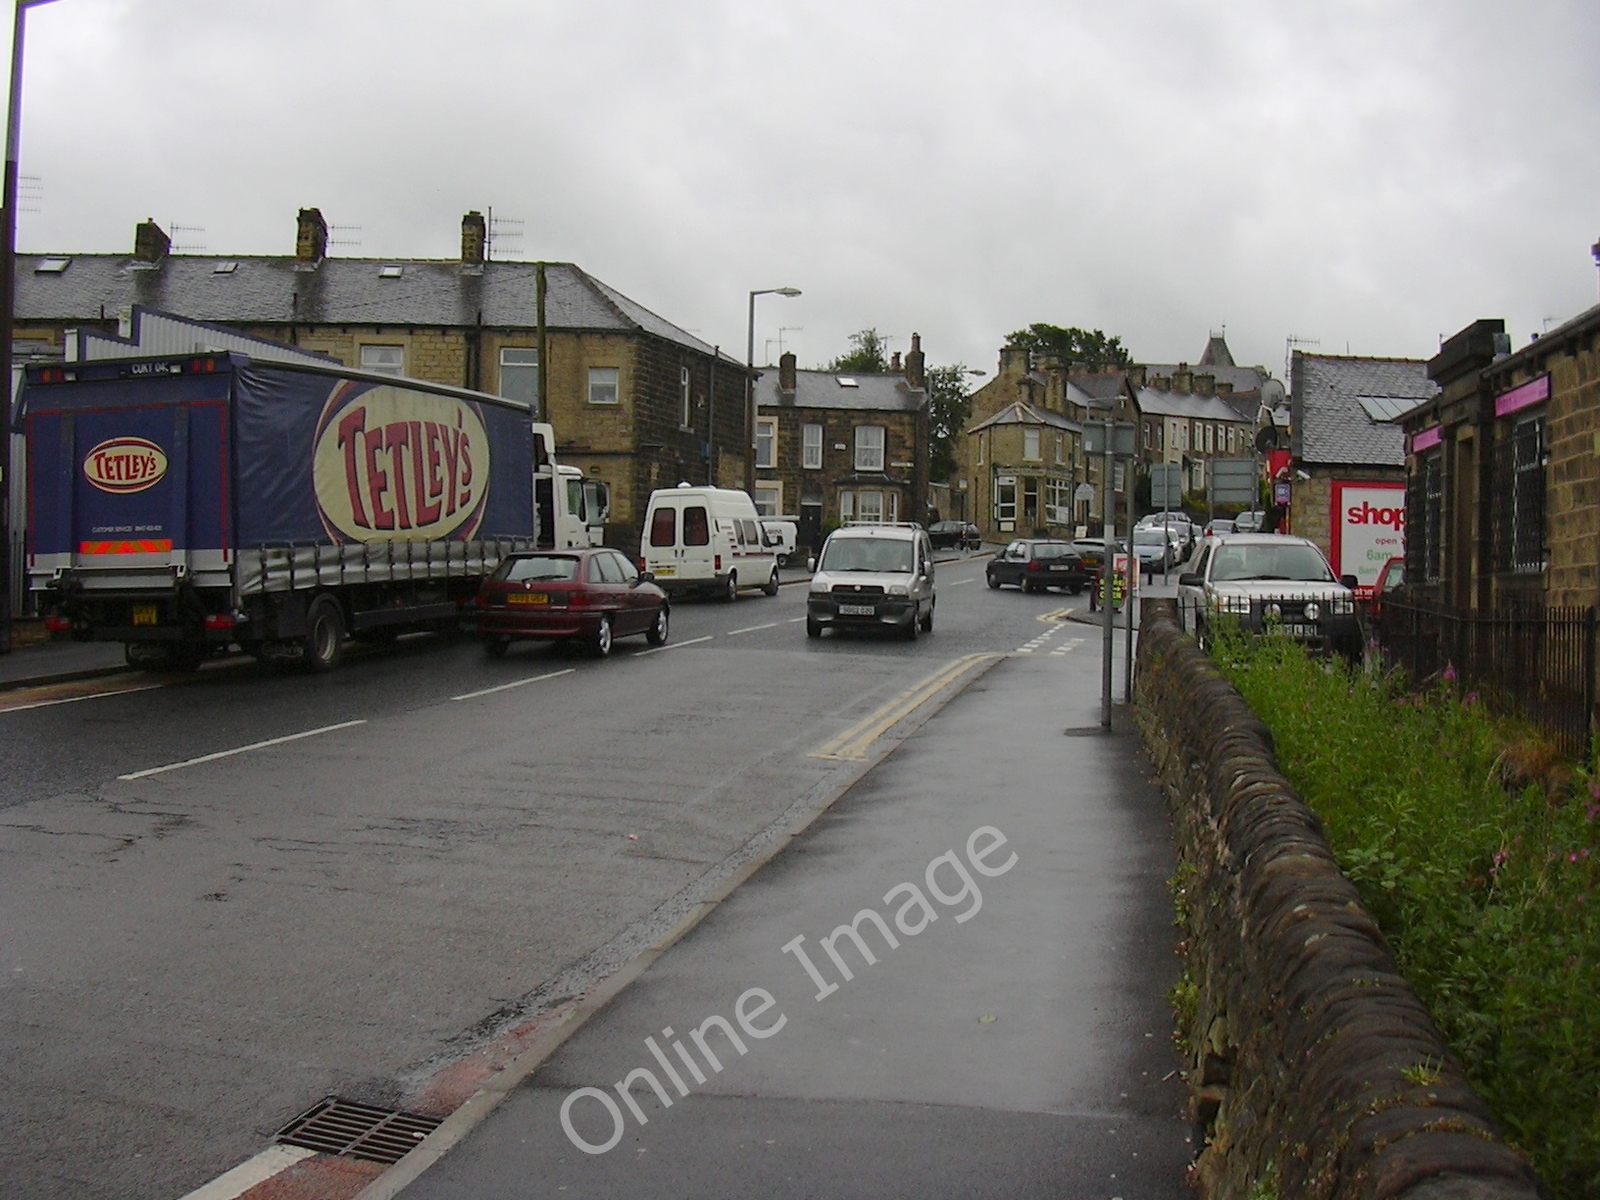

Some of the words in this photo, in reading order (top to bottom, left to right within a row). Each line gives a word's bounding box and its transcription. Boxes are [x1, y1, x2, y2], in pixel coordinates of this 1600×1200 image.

[94, 451, 157, 480] TETLEY'S
[338, 406, 473, 530] TETLEY'S
[1347, 501, 1406, 531] shop
[1366, 549, 1393, 561] 6am
[1375, 538, 1398, 546] open
